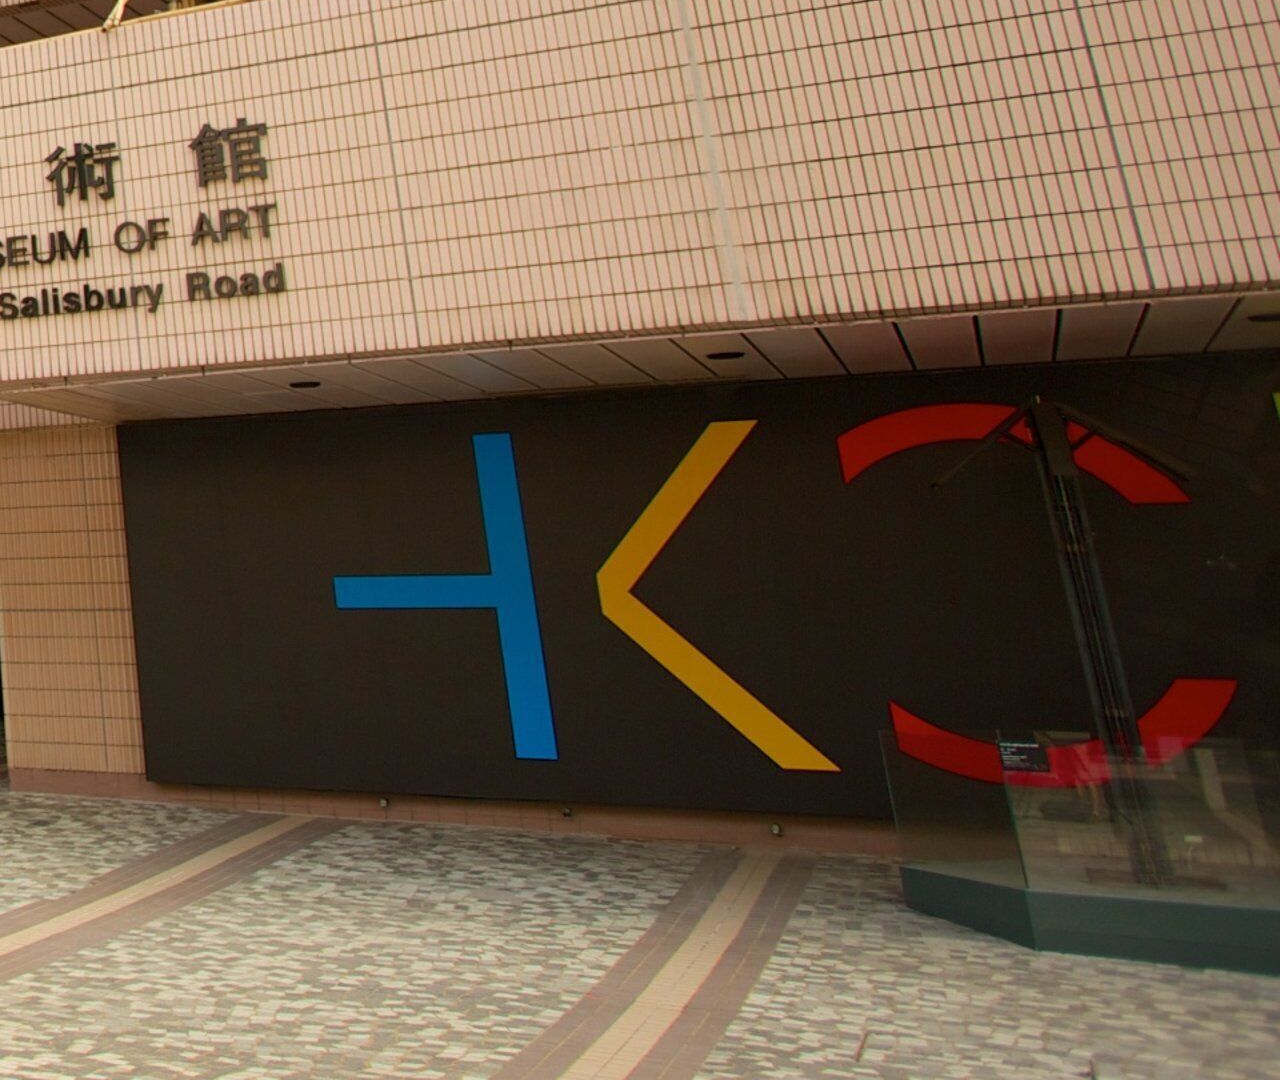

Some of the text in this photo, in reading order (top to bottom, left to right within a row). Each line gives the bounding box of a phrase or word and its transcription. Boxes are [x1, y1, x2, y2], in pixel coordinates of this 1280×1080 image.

[113, 217, 172, 255] OF
[190, 202, 278, 247] ART
[185, 263, 287, 302] Road
